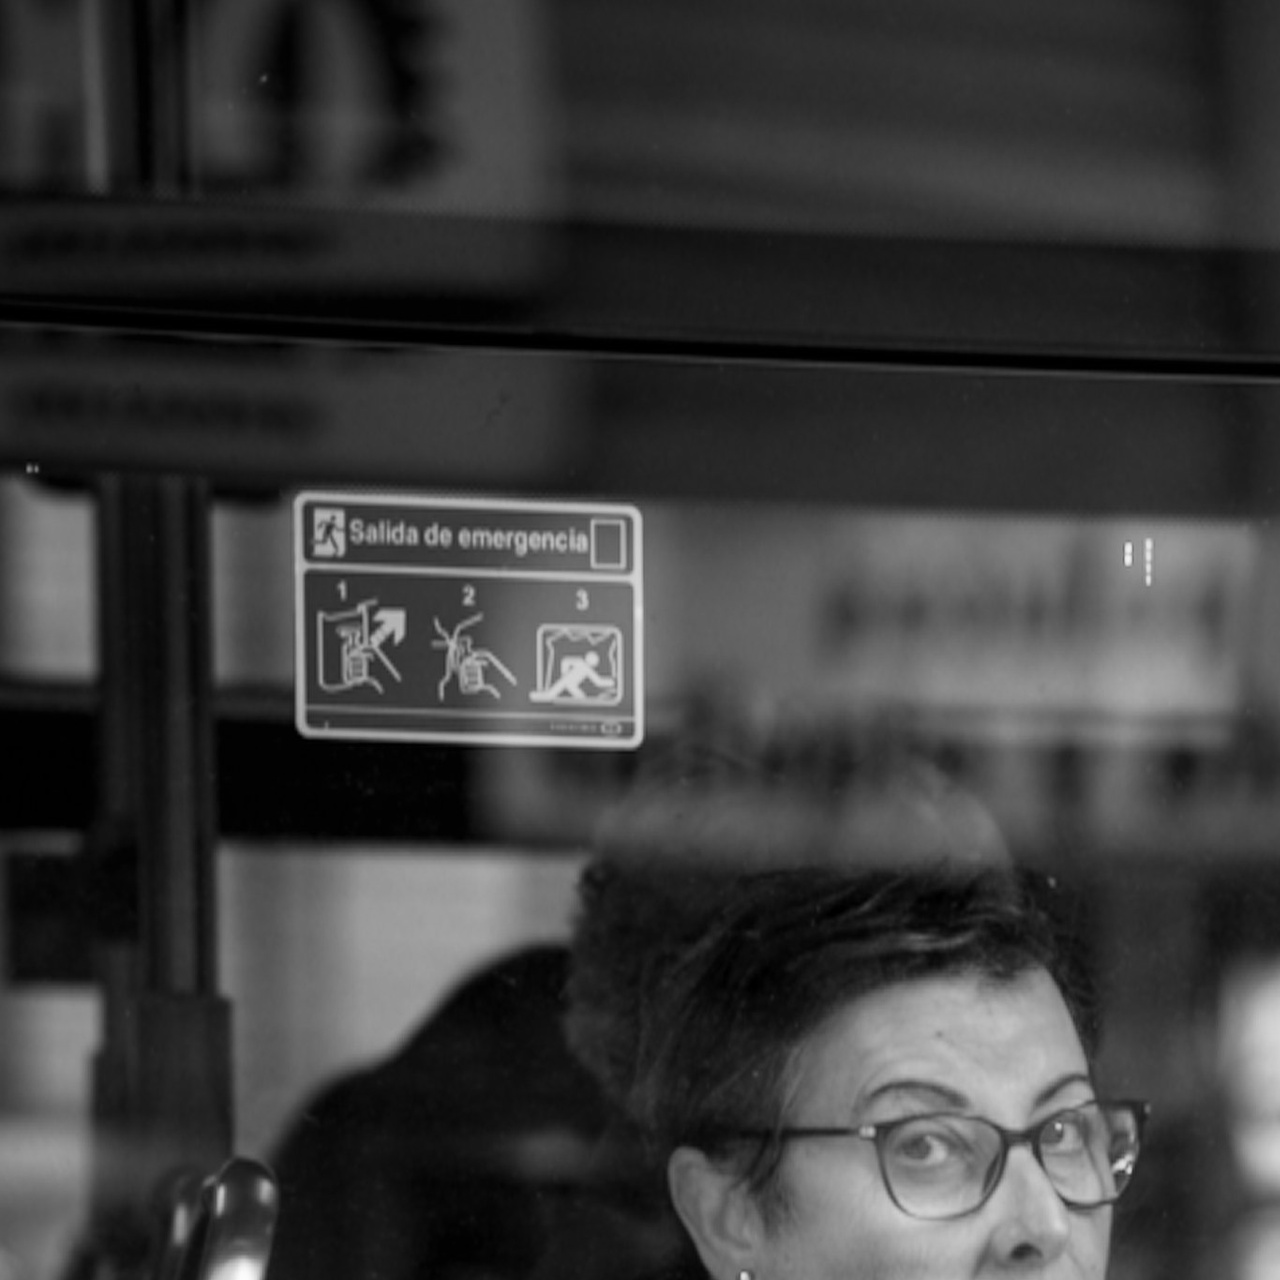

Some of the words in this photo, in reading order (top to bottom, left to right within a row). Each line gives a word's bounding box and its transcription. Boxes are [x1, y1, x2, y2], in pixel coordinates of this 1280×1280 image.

[349, 518, 419, 547] Salida
[424, 522, 453, 547] de
[458, 527, 589, 556] emergencia
[337, 579, 348, 601] 1
[463, 585, 476, 606] 2
[576, 589, 590, 612] 3
